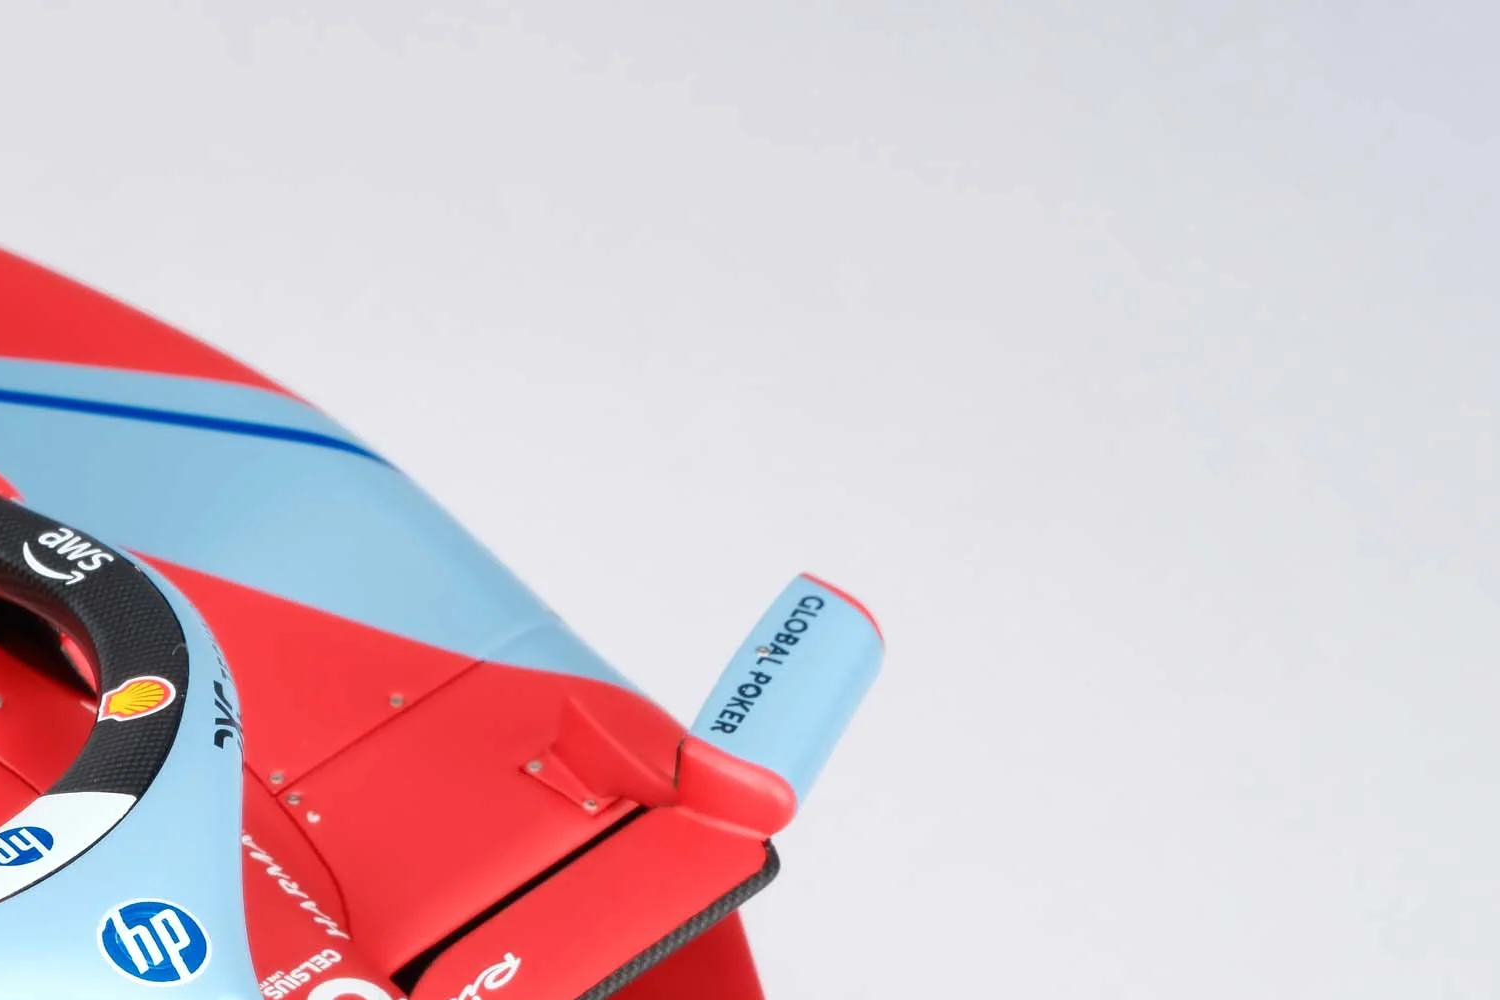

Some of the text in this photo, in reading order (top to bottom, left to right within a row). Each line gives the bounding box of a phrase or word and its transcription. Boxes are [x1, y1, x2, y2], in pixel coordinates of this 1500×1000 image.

[38, 527, 114, 571] aws
[757, 595, 825, 669] GLOBAL
[710, 670, 773, 735] POKER
[108, 902, 192, 982] hp
